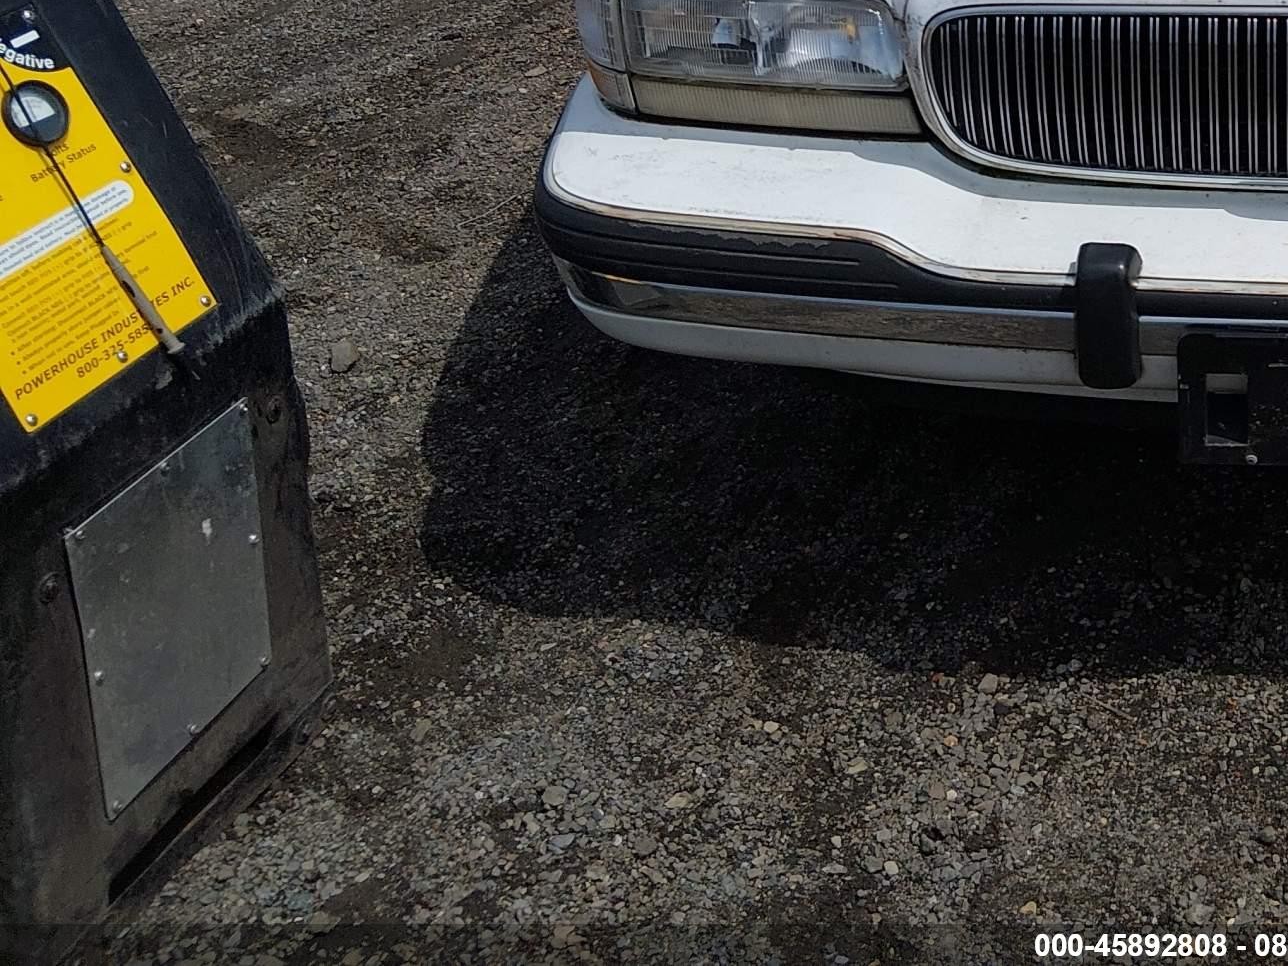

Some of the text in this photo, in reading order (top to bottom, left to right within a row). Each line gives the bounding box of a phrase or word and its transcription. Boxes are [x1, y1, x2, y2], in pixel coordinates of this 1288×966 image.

[0, 38, 55, 69] egative
[66, 144, 97, 164] Status
[14, 338, 99, 401] POWERHOUSE
[171, 276, 196, 307] INC.
[76, 321, 154, 379] 800-325-585
